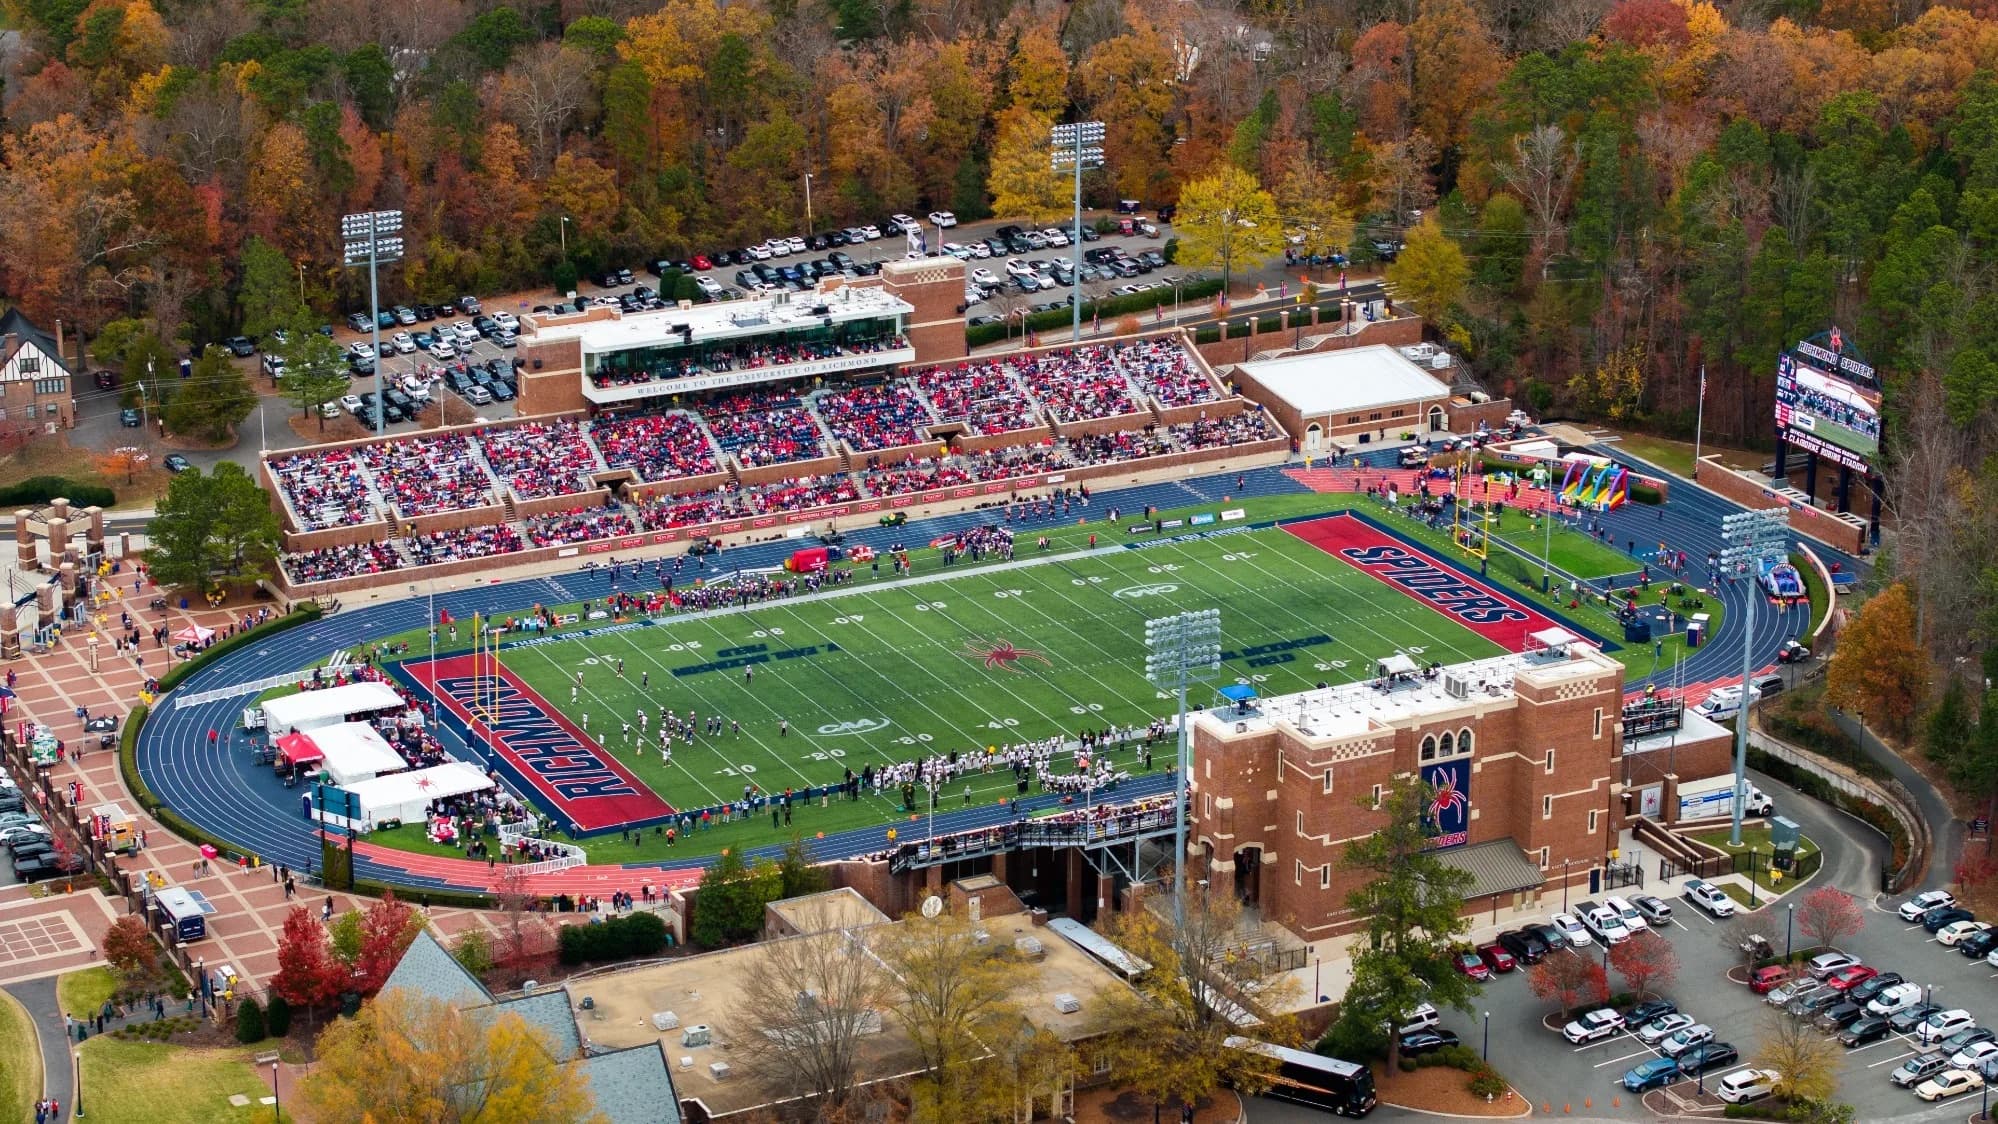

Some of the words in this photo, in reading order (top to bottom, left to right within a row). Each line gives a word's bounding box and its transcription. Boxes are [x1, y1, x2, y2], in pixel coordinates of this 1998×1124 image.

[1798, 341, 1838, 365] RICHMOND
[1841, 357, 1874, 379] SPIDERS
[637, 383, 687, 394] WELCOME
[694, 380, 706, 388] TO
[736, 367, 799, 382] UNIVERSITY
[804, 365, 817, 373] OF
[822, 357, 878, 370] RICHMOND
[1222, 551, 1252, 561] 10
[1122, 583, 1179, 598] CAA
[1340, 546, 1530, 624] SPIDERS
[915, 601, 947, 611] 50
[834, 614, 864, 624] 40
[510, 636, 557, 648] THANK
[558, 632, 585, 640] YOU
[584, 654, 617, 665] 10
[1313, 660, 1347, 672] 20
[1069, 703, 1104, 715] 50
[817, 718, 878, 734] CAA
[988, 718, 1020, 729] 40
[435, 675, 641, 802] RICHMOND
[810, 749, 846, 761] 20
[721, 764, 757, 776] 10
